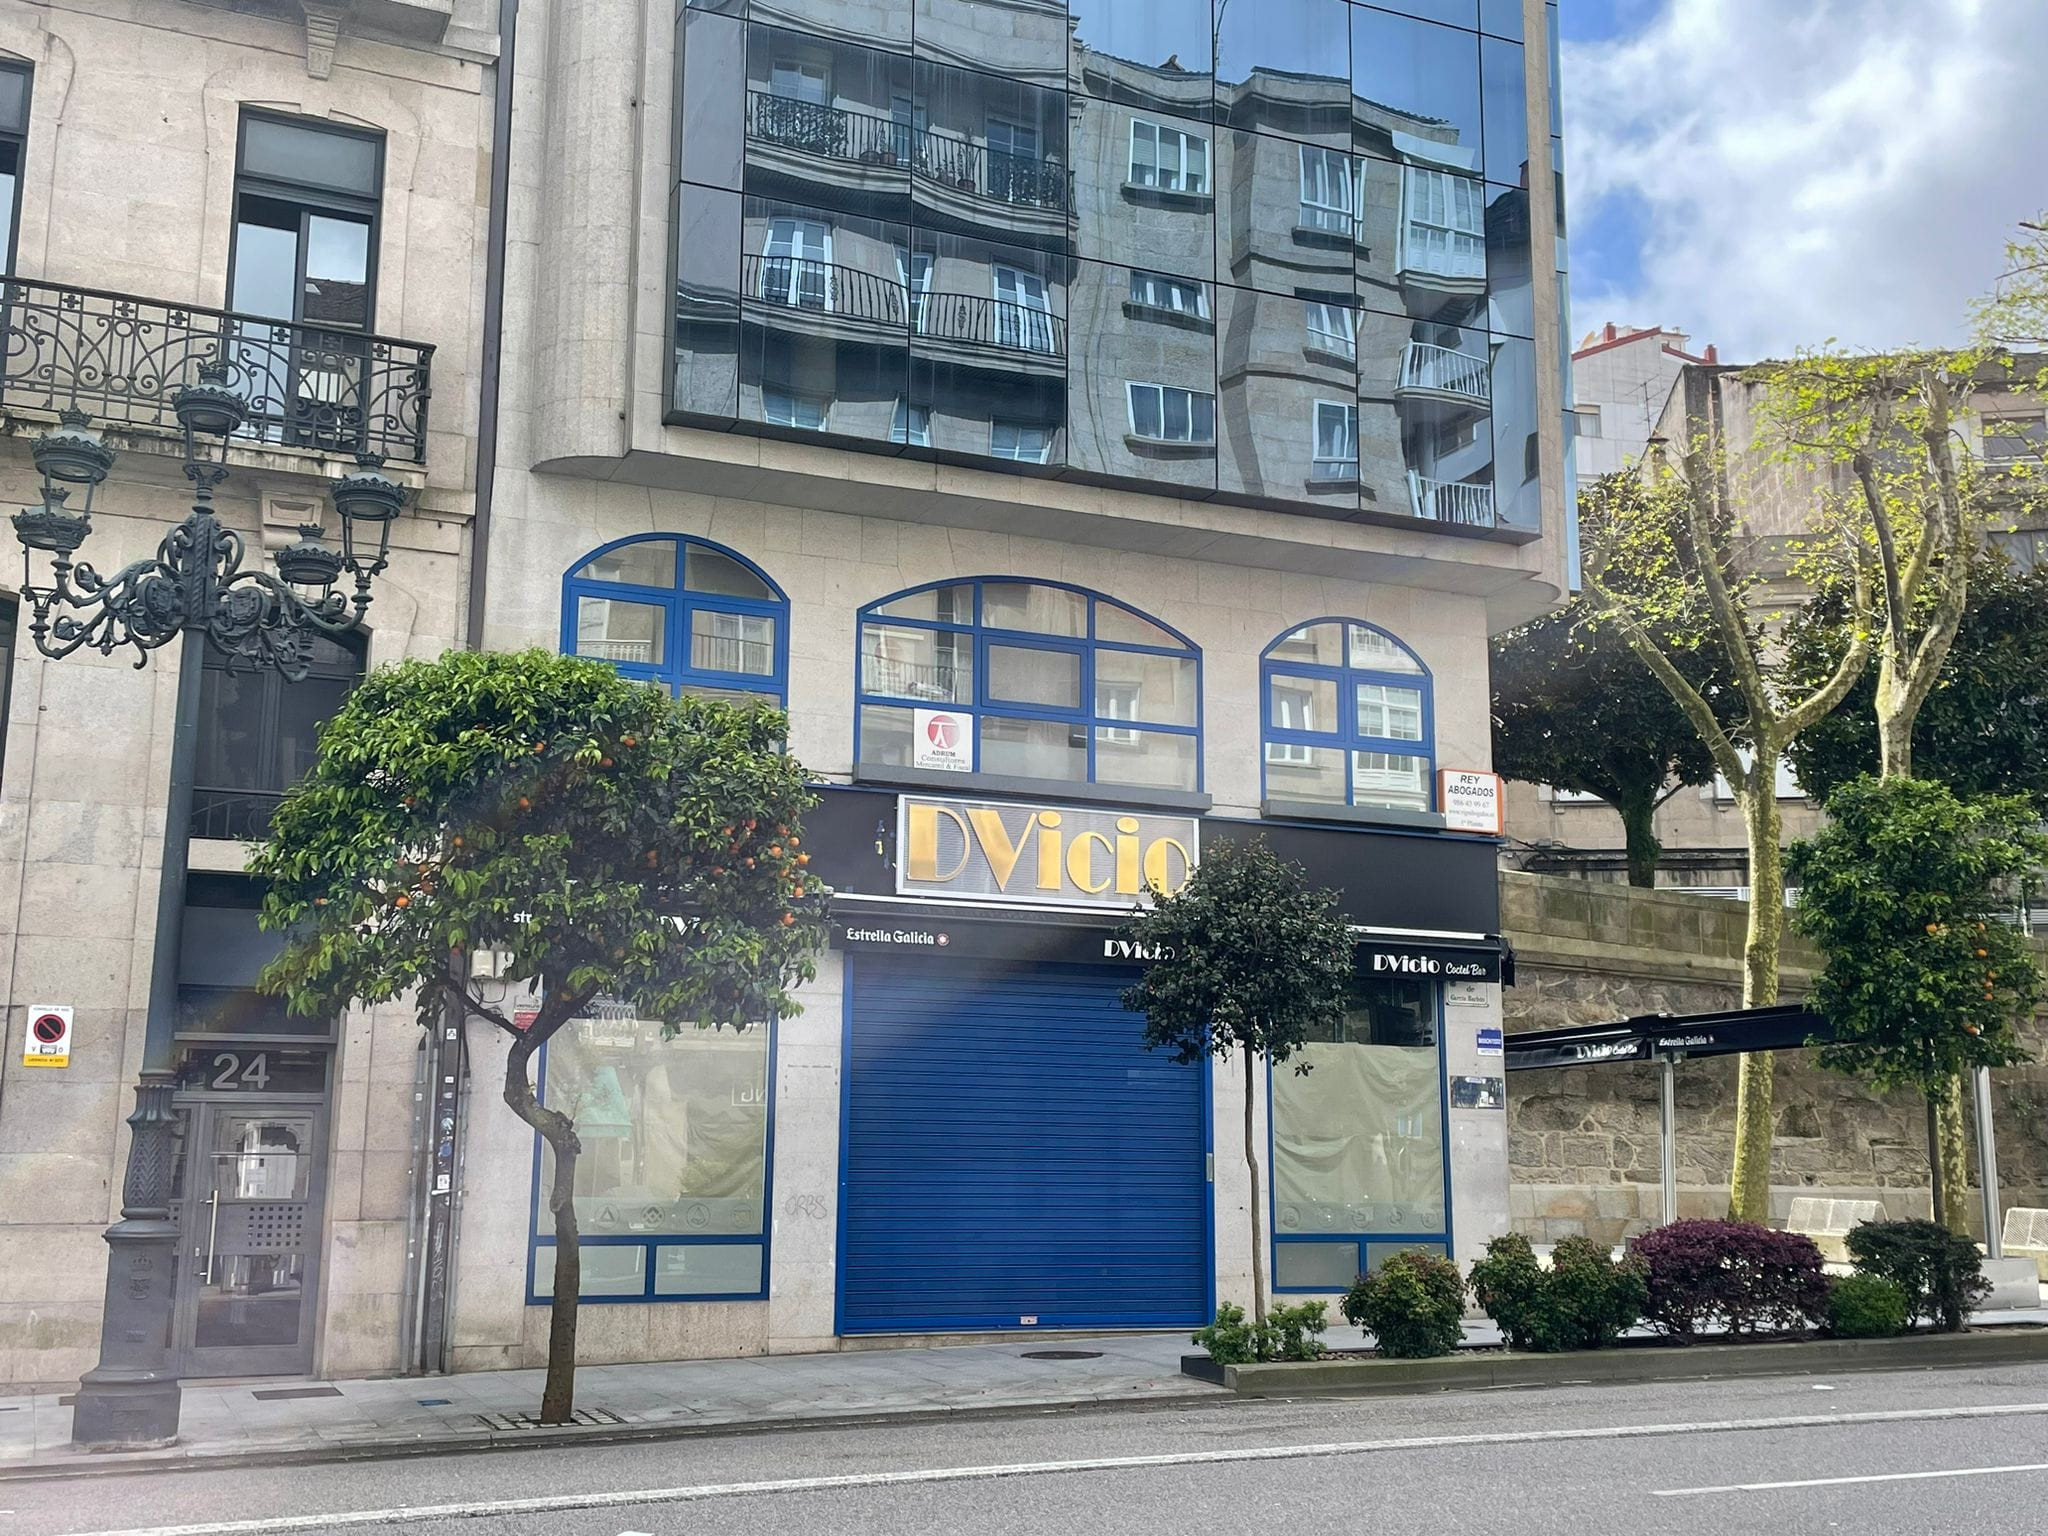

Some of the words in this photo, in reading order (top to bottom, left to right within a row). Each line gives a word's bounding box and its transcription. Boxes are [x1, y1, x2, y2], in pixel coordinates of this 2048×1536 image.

[1460, 774, 1480, 784] REY
[1448, 785, 1493, 797] ABOGADOS
[907, 803, 1193, 898] DVicio
[846, 927, 892, 942] Estrella
[893, 930, 935, 945] Galicia
[1373, 954, 1440, 974] DVicio
[1470, 963, 1487, 976] Bar
[1659, 1036, 1684, 1046] Estrella
[1684, 1035, 1708, 1045] Galicia
[212, 1053, 271, 1090] 24
